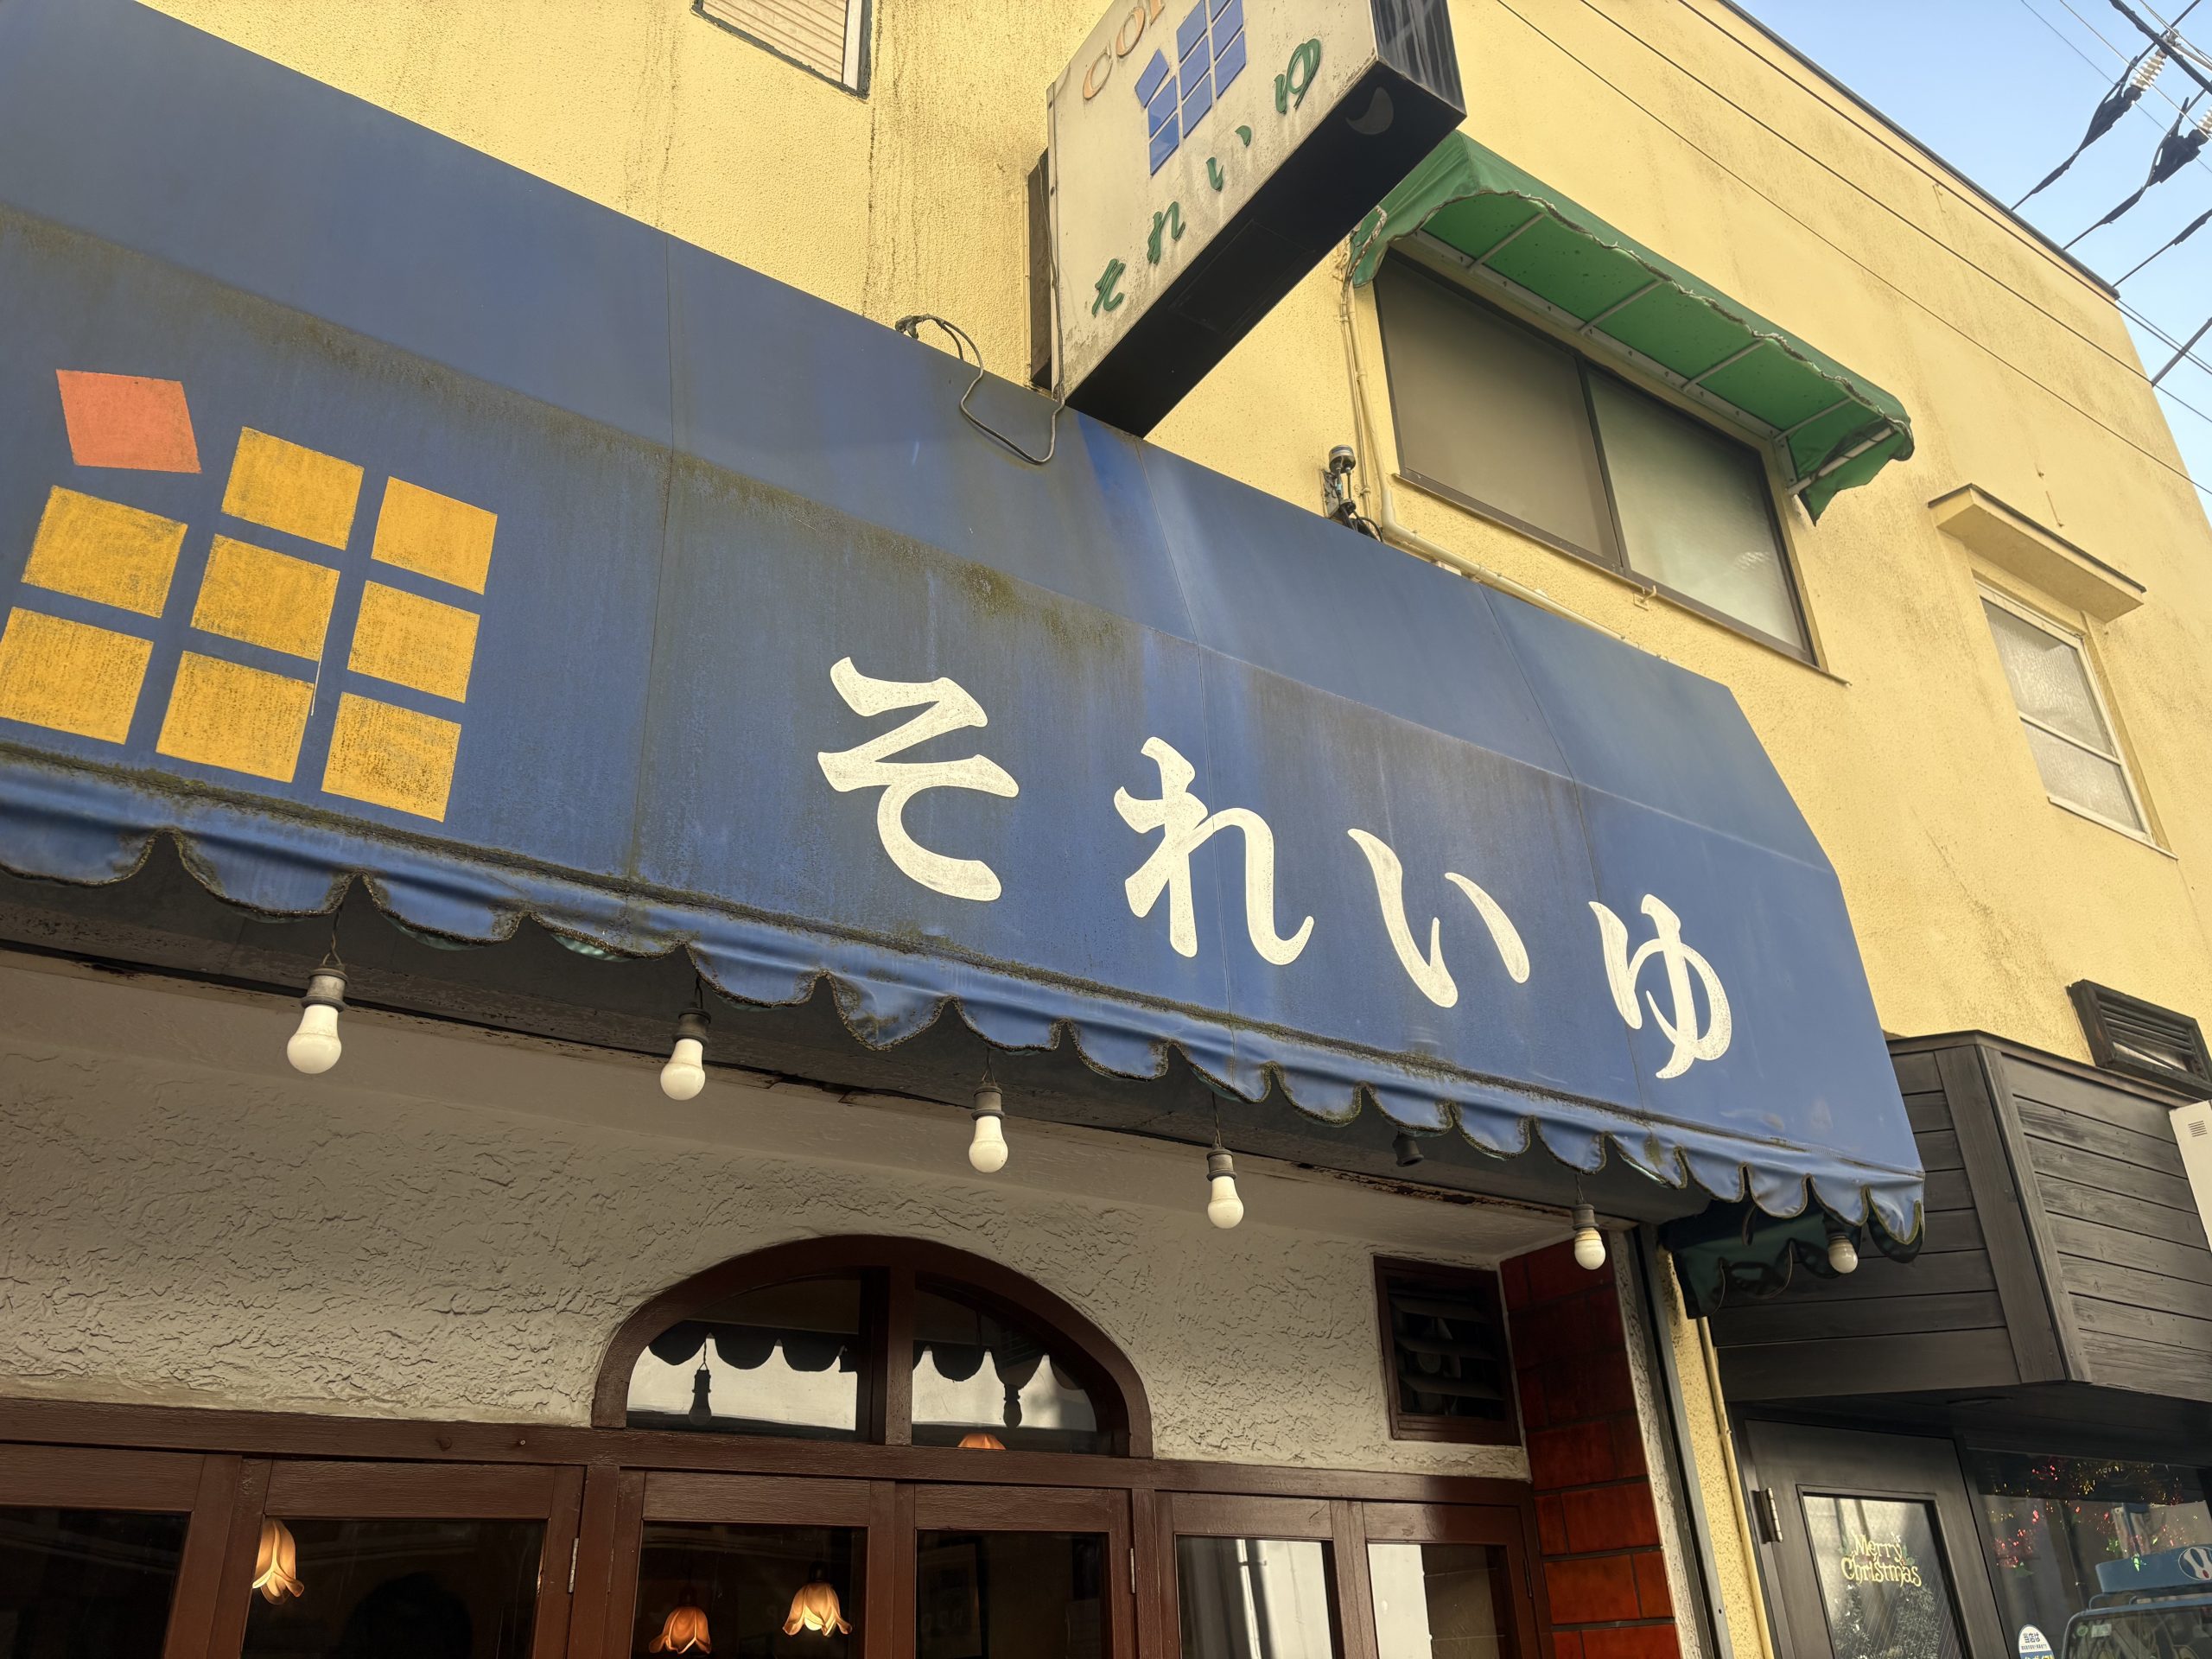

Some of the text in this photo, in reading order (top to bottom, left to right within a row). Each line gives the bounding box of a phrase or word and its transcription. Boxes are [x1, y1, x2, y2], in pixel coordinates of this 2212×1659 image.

[1082, 0, 1166, 101] CO
[1091, 37, 1322, 315] それいゆ
[818, 656, 1732, 1079] それいゆ
[1840, 1555, 1923, 1587] Christmas
[1850, 1529, 1904, 1563] Merry
